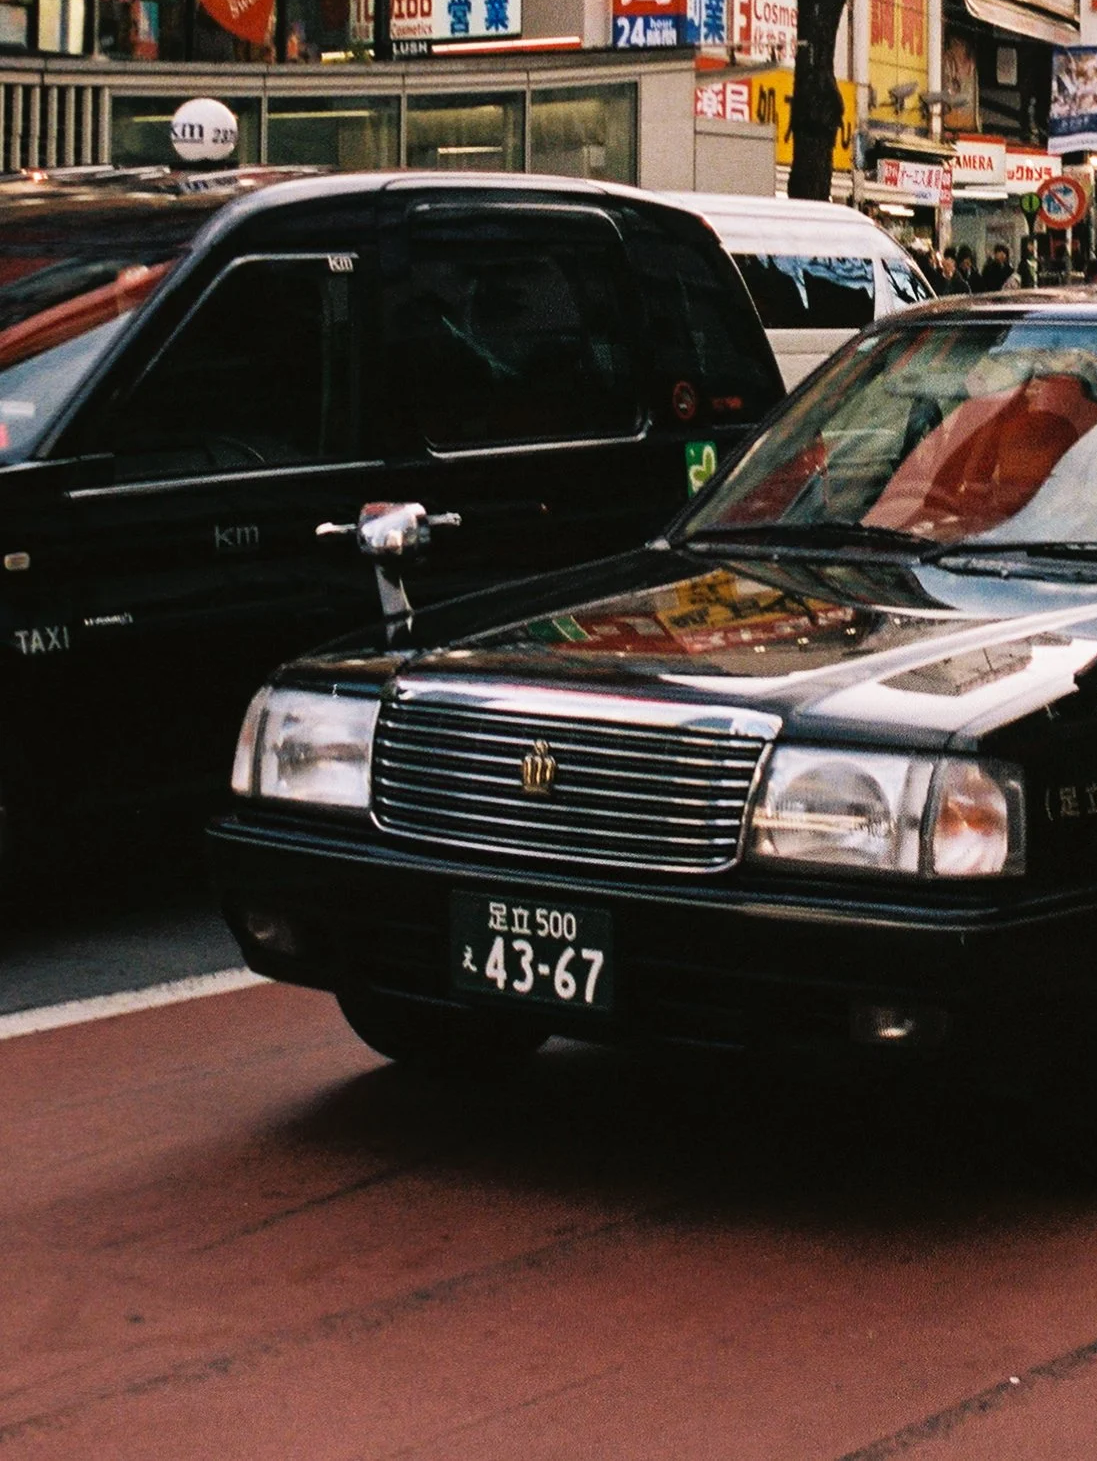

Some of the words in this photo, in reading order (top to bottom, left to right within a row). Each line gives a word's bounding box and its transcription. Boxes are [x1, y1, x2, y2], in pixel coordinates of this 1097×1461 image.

[616, 17, 645, 47] 24
[697, 84, 750, 122] 薬局
[328, 255, 353, 273] km
[214, 524, 260, 549] km
[14, 625, 70, 655] TAXI
[488, 901, 533, 935] 足立
[536, 907, 577, 942] 500
[485, 935, 605, 1004] 43-67
